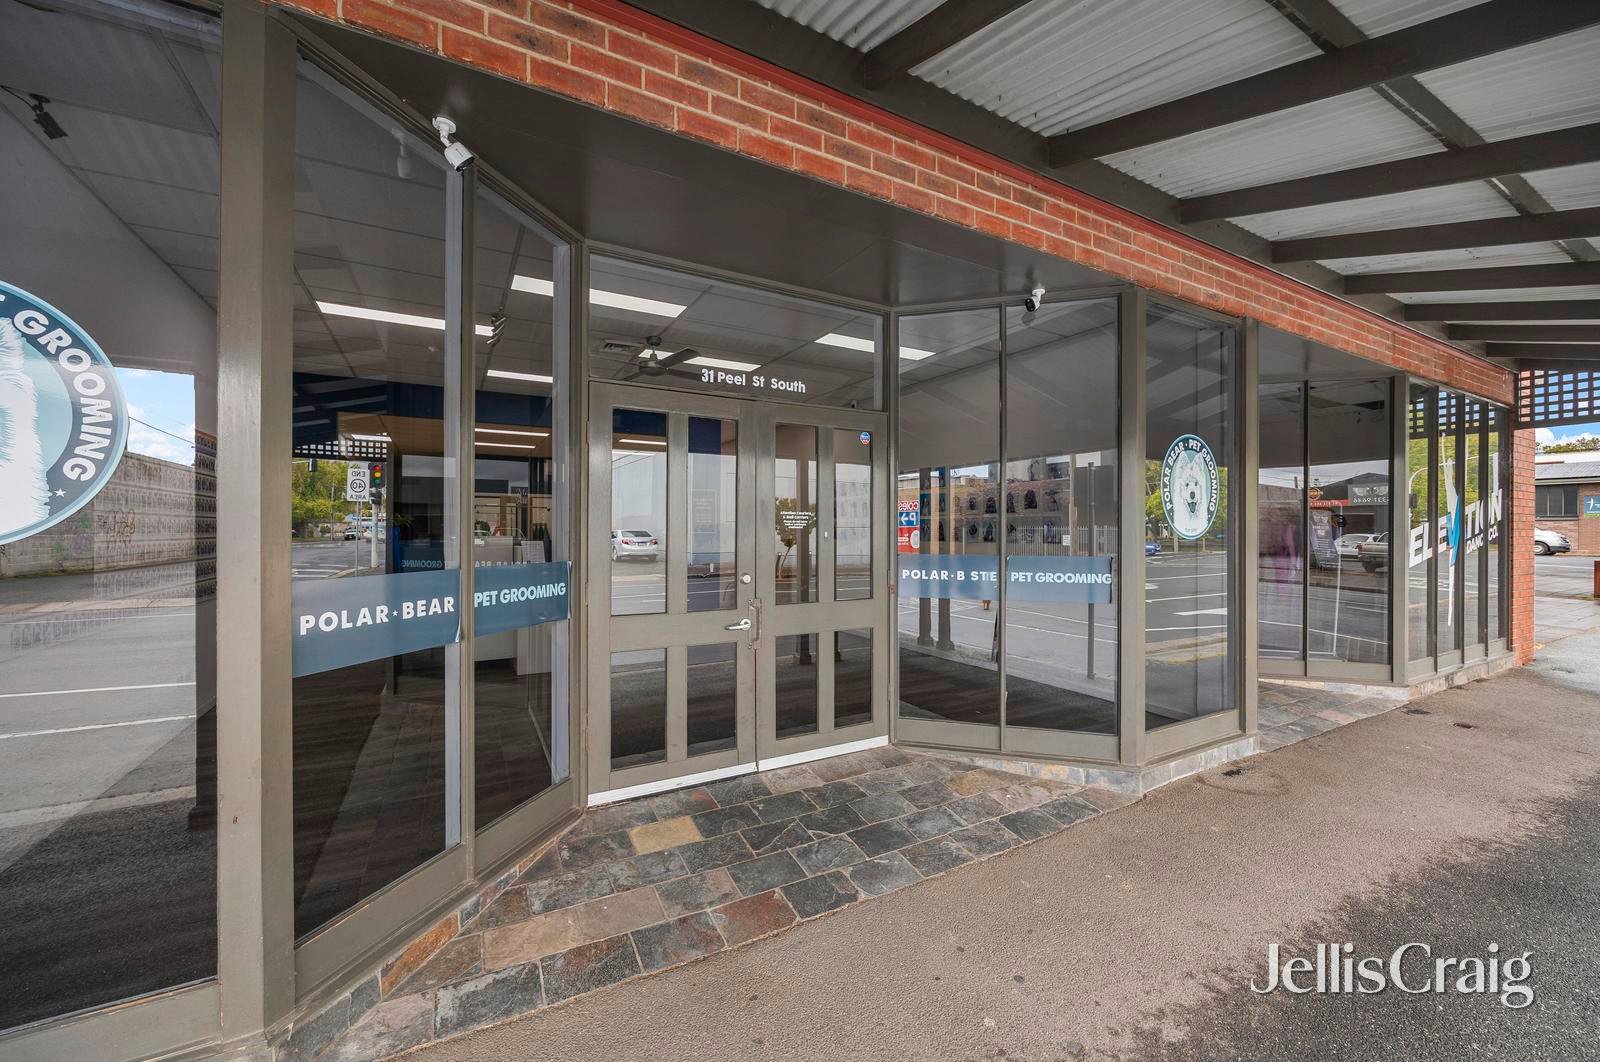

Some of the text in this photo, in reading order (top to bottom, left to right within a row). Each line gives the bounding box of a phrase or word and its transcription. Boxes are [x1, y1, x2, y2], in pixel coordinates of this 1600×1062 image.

[13, 309, 113, 482] GROOMING
[701, 368, 806, 393] 31 Peel St South
[1163, 439, 1218, 512] POLAR BEAR PET GROOMING
[902, 569, 949, 581] POLAR
[1010, 571, 1033, 583] PET
[1035, 572, 1113, 585] GROOMING
[474, 581, 567, 608] PET GROOMING
[300, 596, 455, 636] POLAR BEAR
